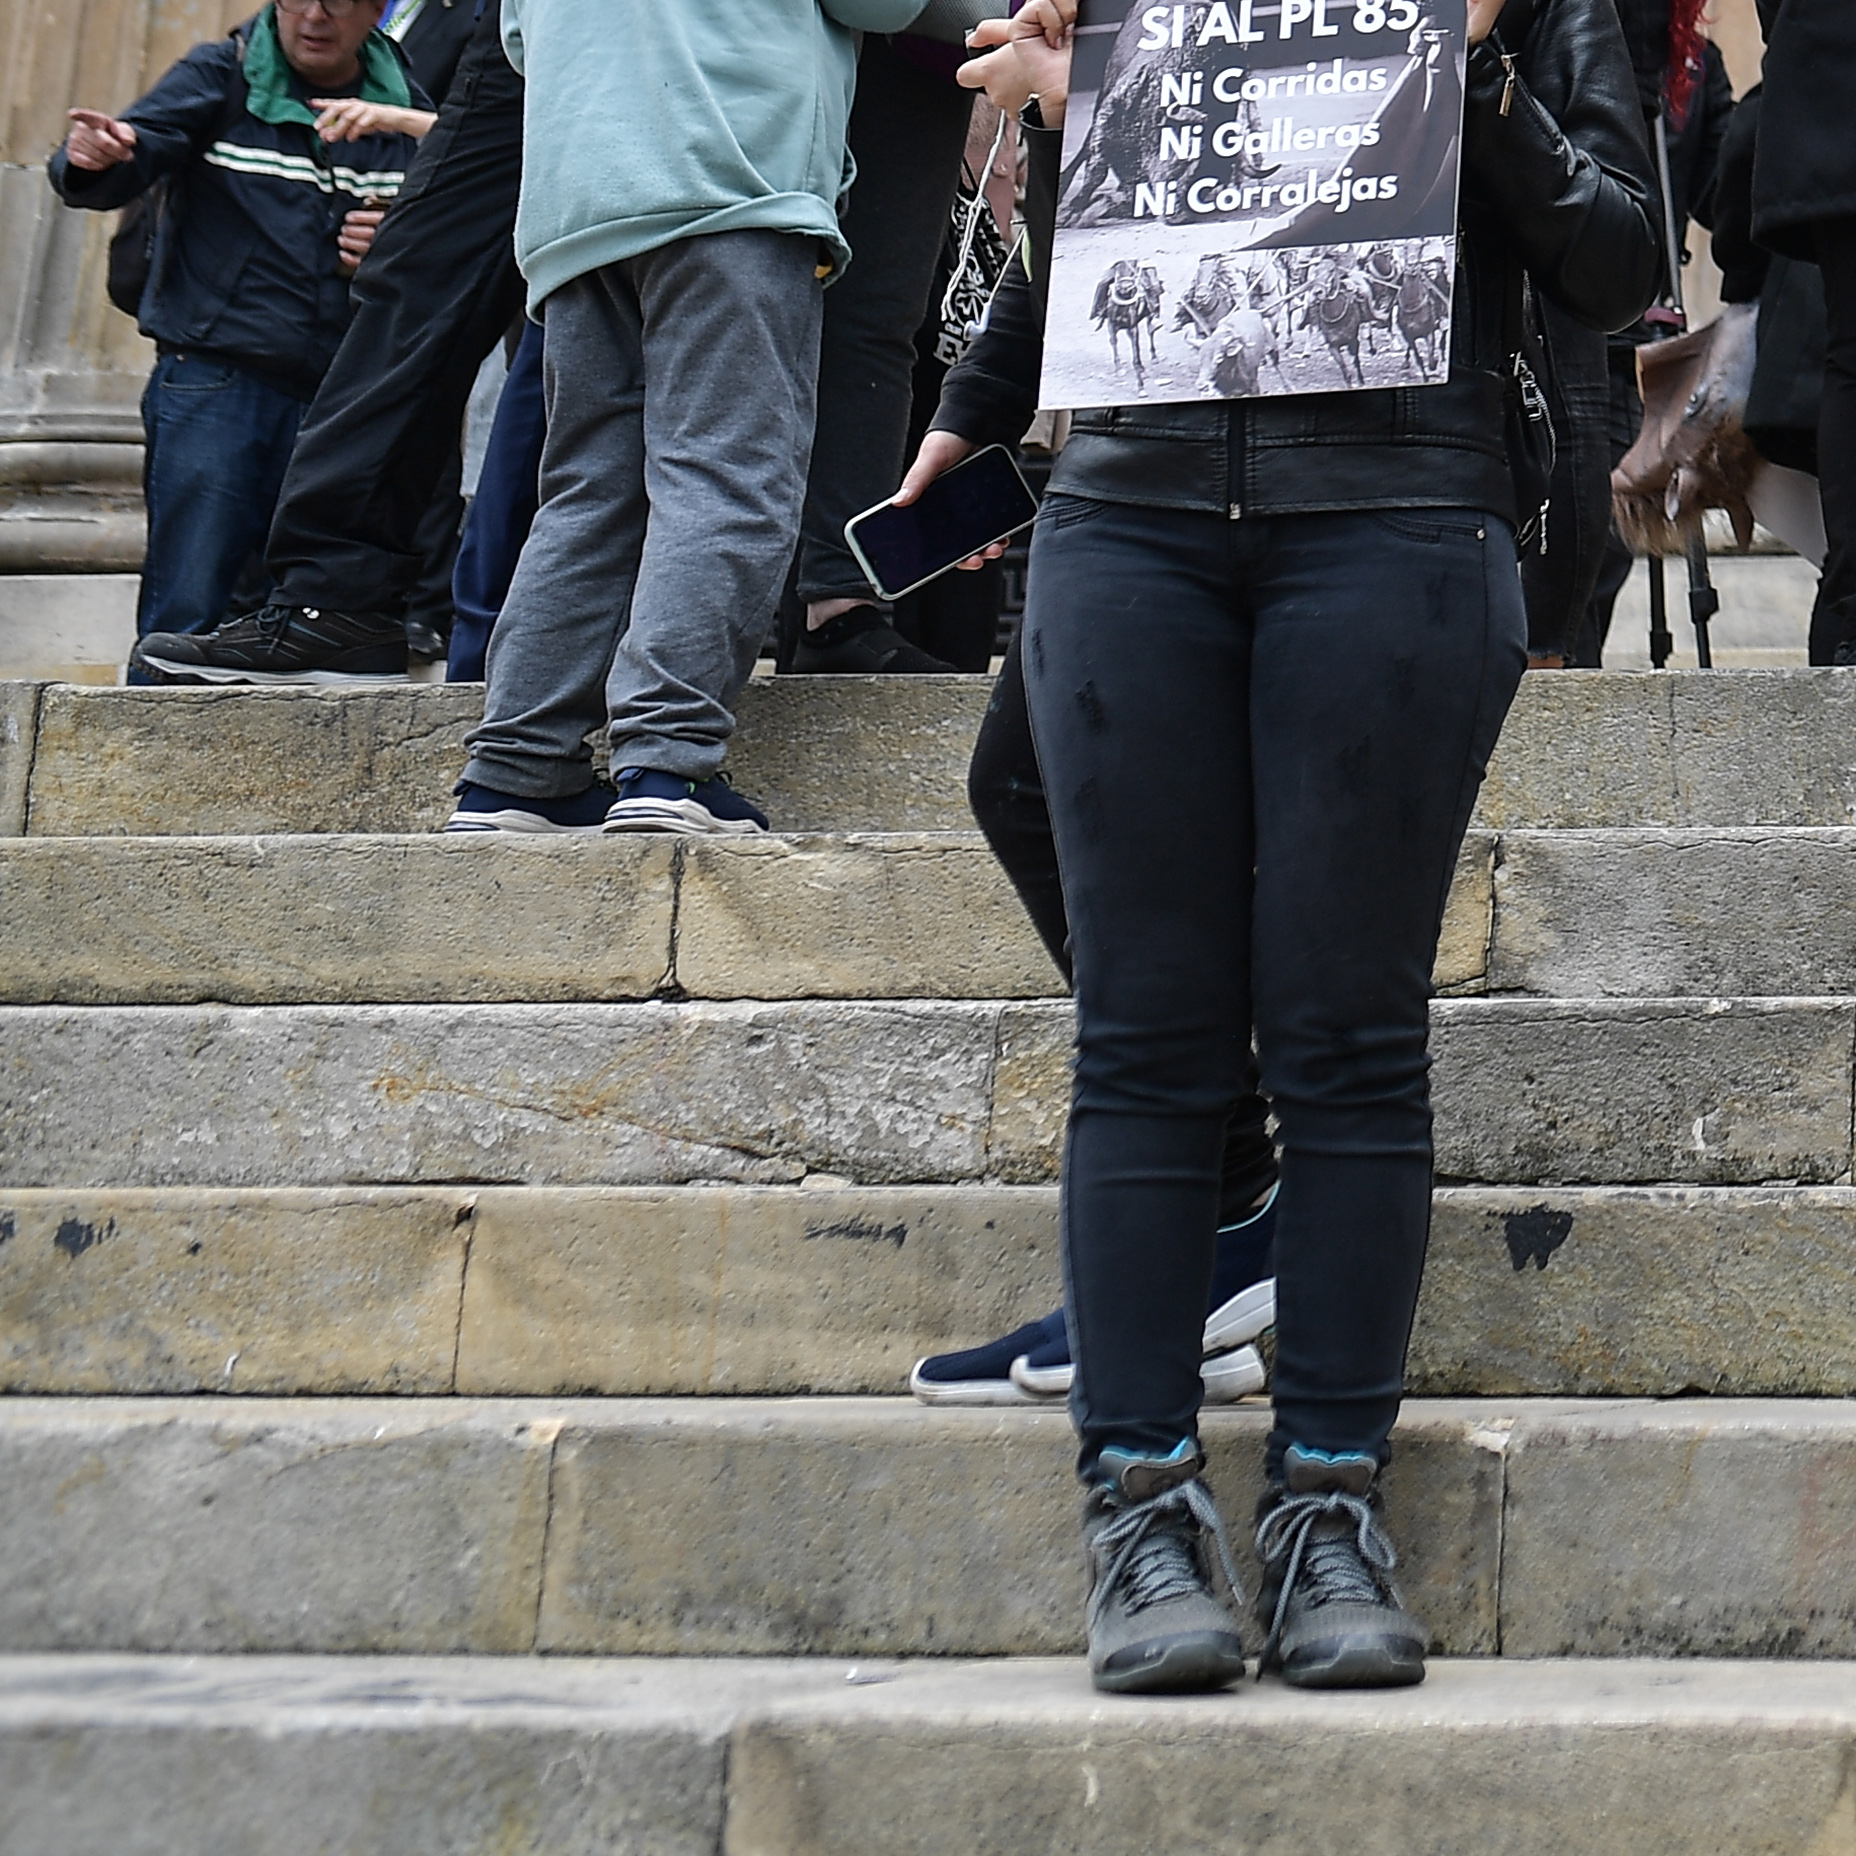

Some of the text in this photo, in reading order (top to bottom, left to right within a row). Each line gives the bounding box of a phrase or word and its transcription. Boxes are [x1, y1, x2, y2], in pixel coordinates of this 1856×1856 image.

[1137, 5, 1186, 51] SI
[1196, 0, 1264, 46] AL
[1160, 59, 1388, 108] Ni Corridas
[1159, 117, 1381, 160] Ni Galleras
[1133, 167, 1399, 217] Ni Corralejas
